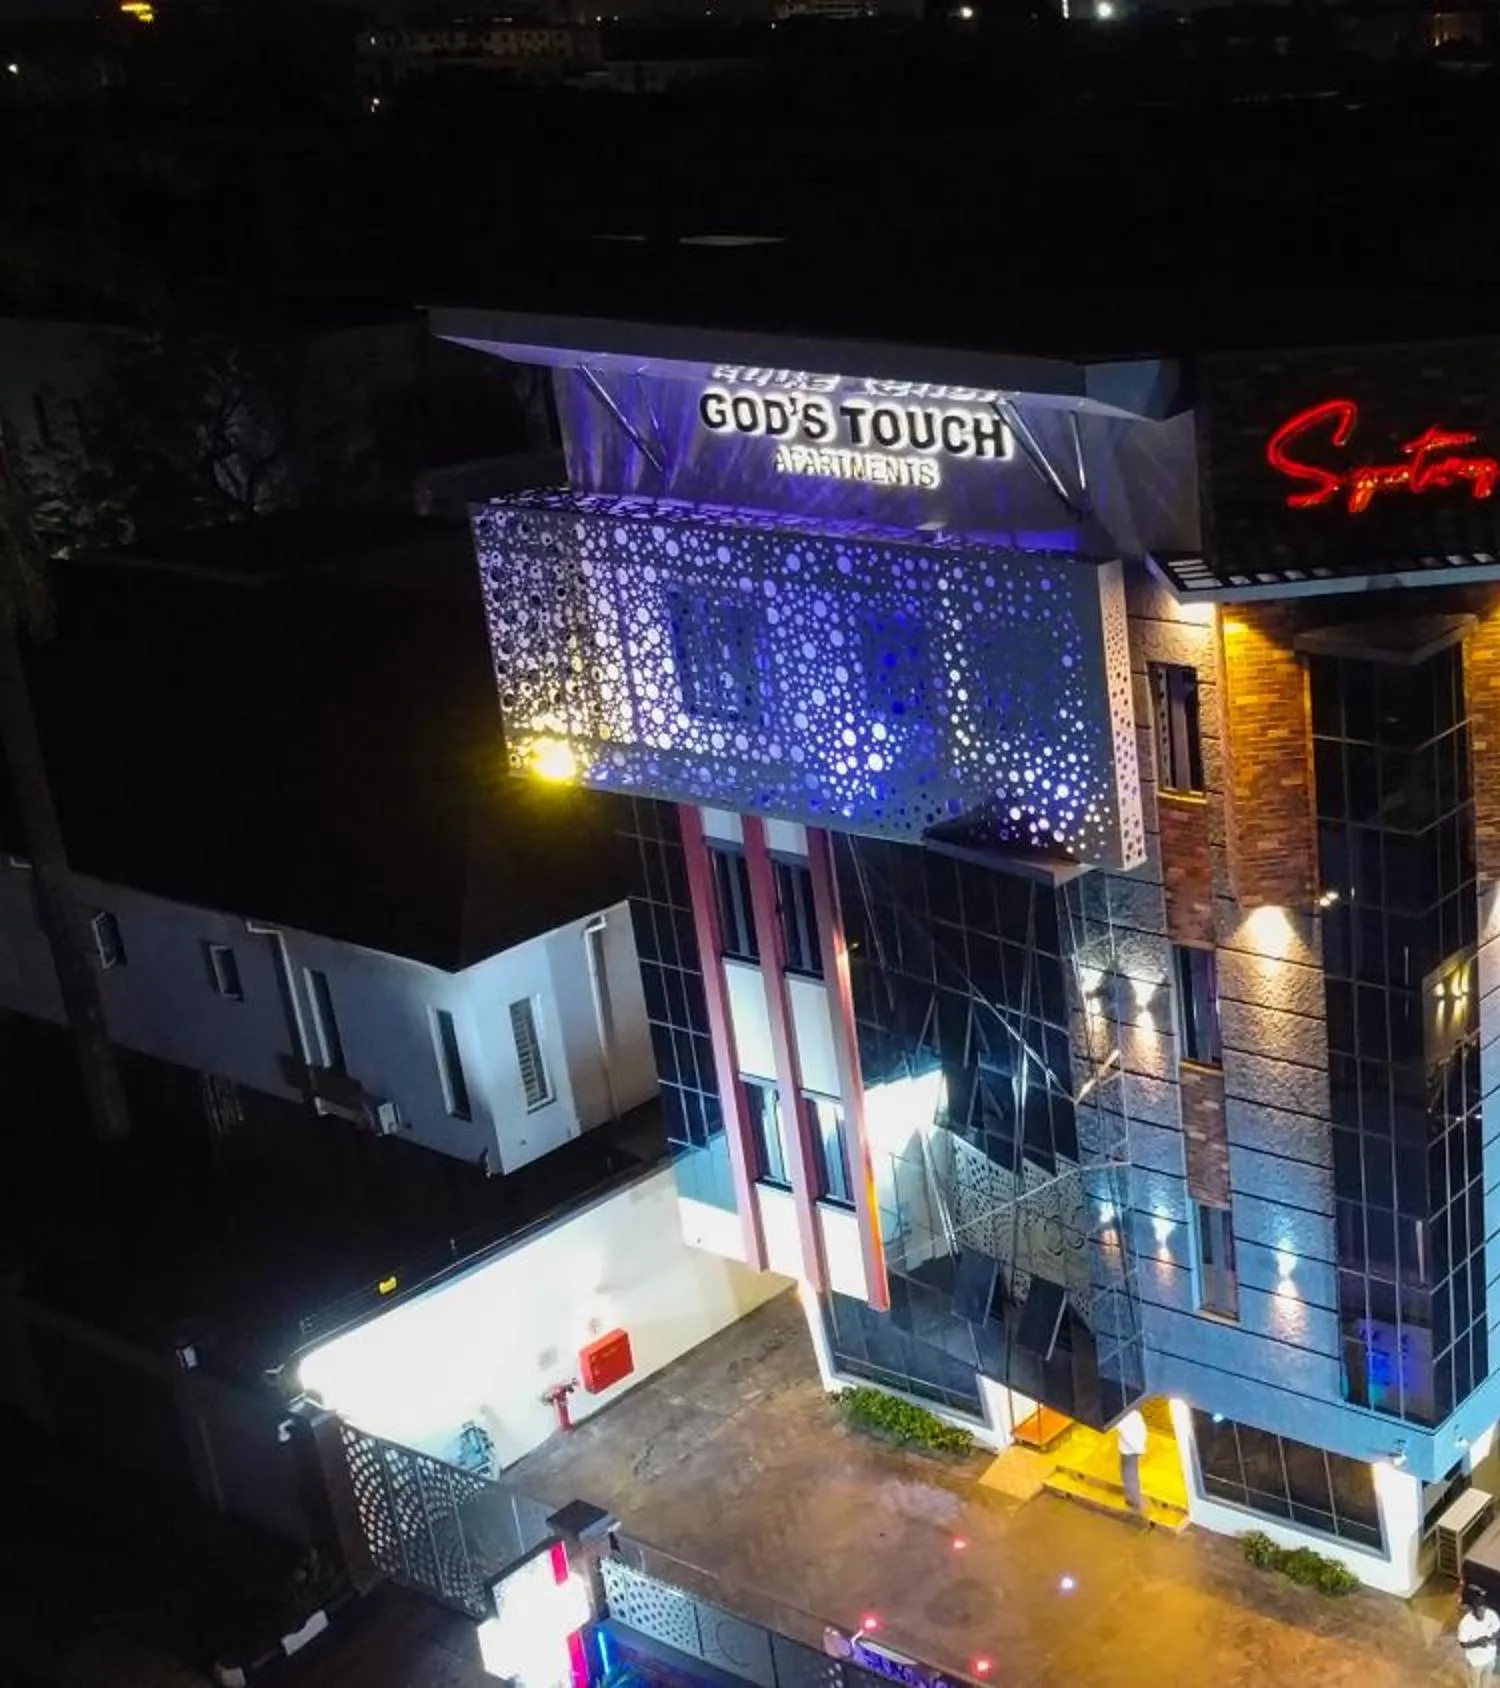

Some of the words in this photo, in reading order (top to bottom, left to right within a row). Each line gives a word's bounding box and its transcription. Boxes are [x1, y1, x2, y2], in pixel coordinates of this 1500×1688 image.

[700, 390, 830, 442] GOD'S
[839, 402, 1009, 459] TOUCH
[774, 445, 940, 489] APARTMENTS
